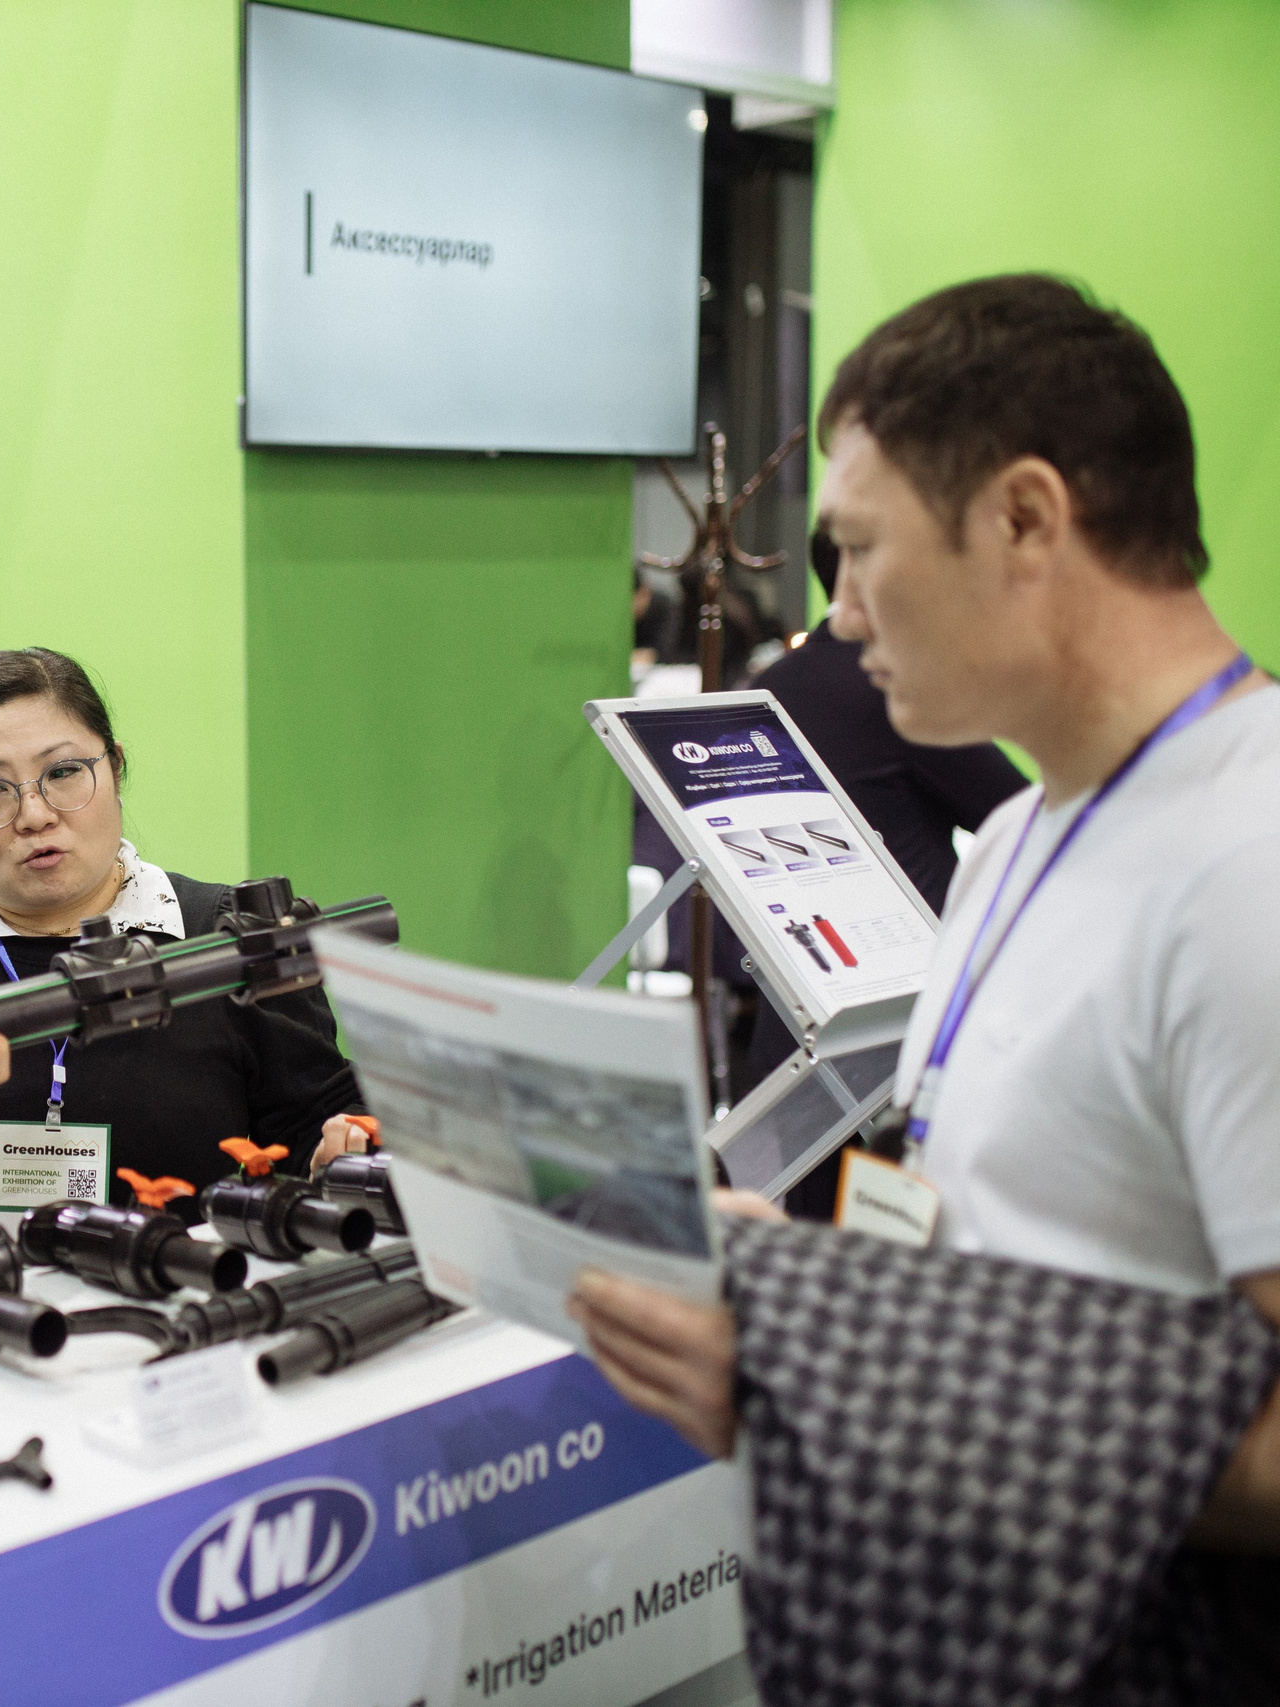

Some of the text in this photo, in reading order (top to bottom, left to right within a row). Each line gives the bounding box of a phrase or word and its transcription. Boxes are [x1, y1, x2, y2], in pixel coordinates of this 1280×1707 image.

[740, 743, 754, 753] CO
[3, 1144, 96, 1157] GreenHouses
[2, 1169, 62, 1177] INTERNATIONAL
[2, 1178, 45, 1186] EXHIBITION
[2, 1187, 57, 1195] GREENHOUSES
[395, 1421, 604, 1536] Kiwoon co
[633, 1549, 743, 1627] Materia
